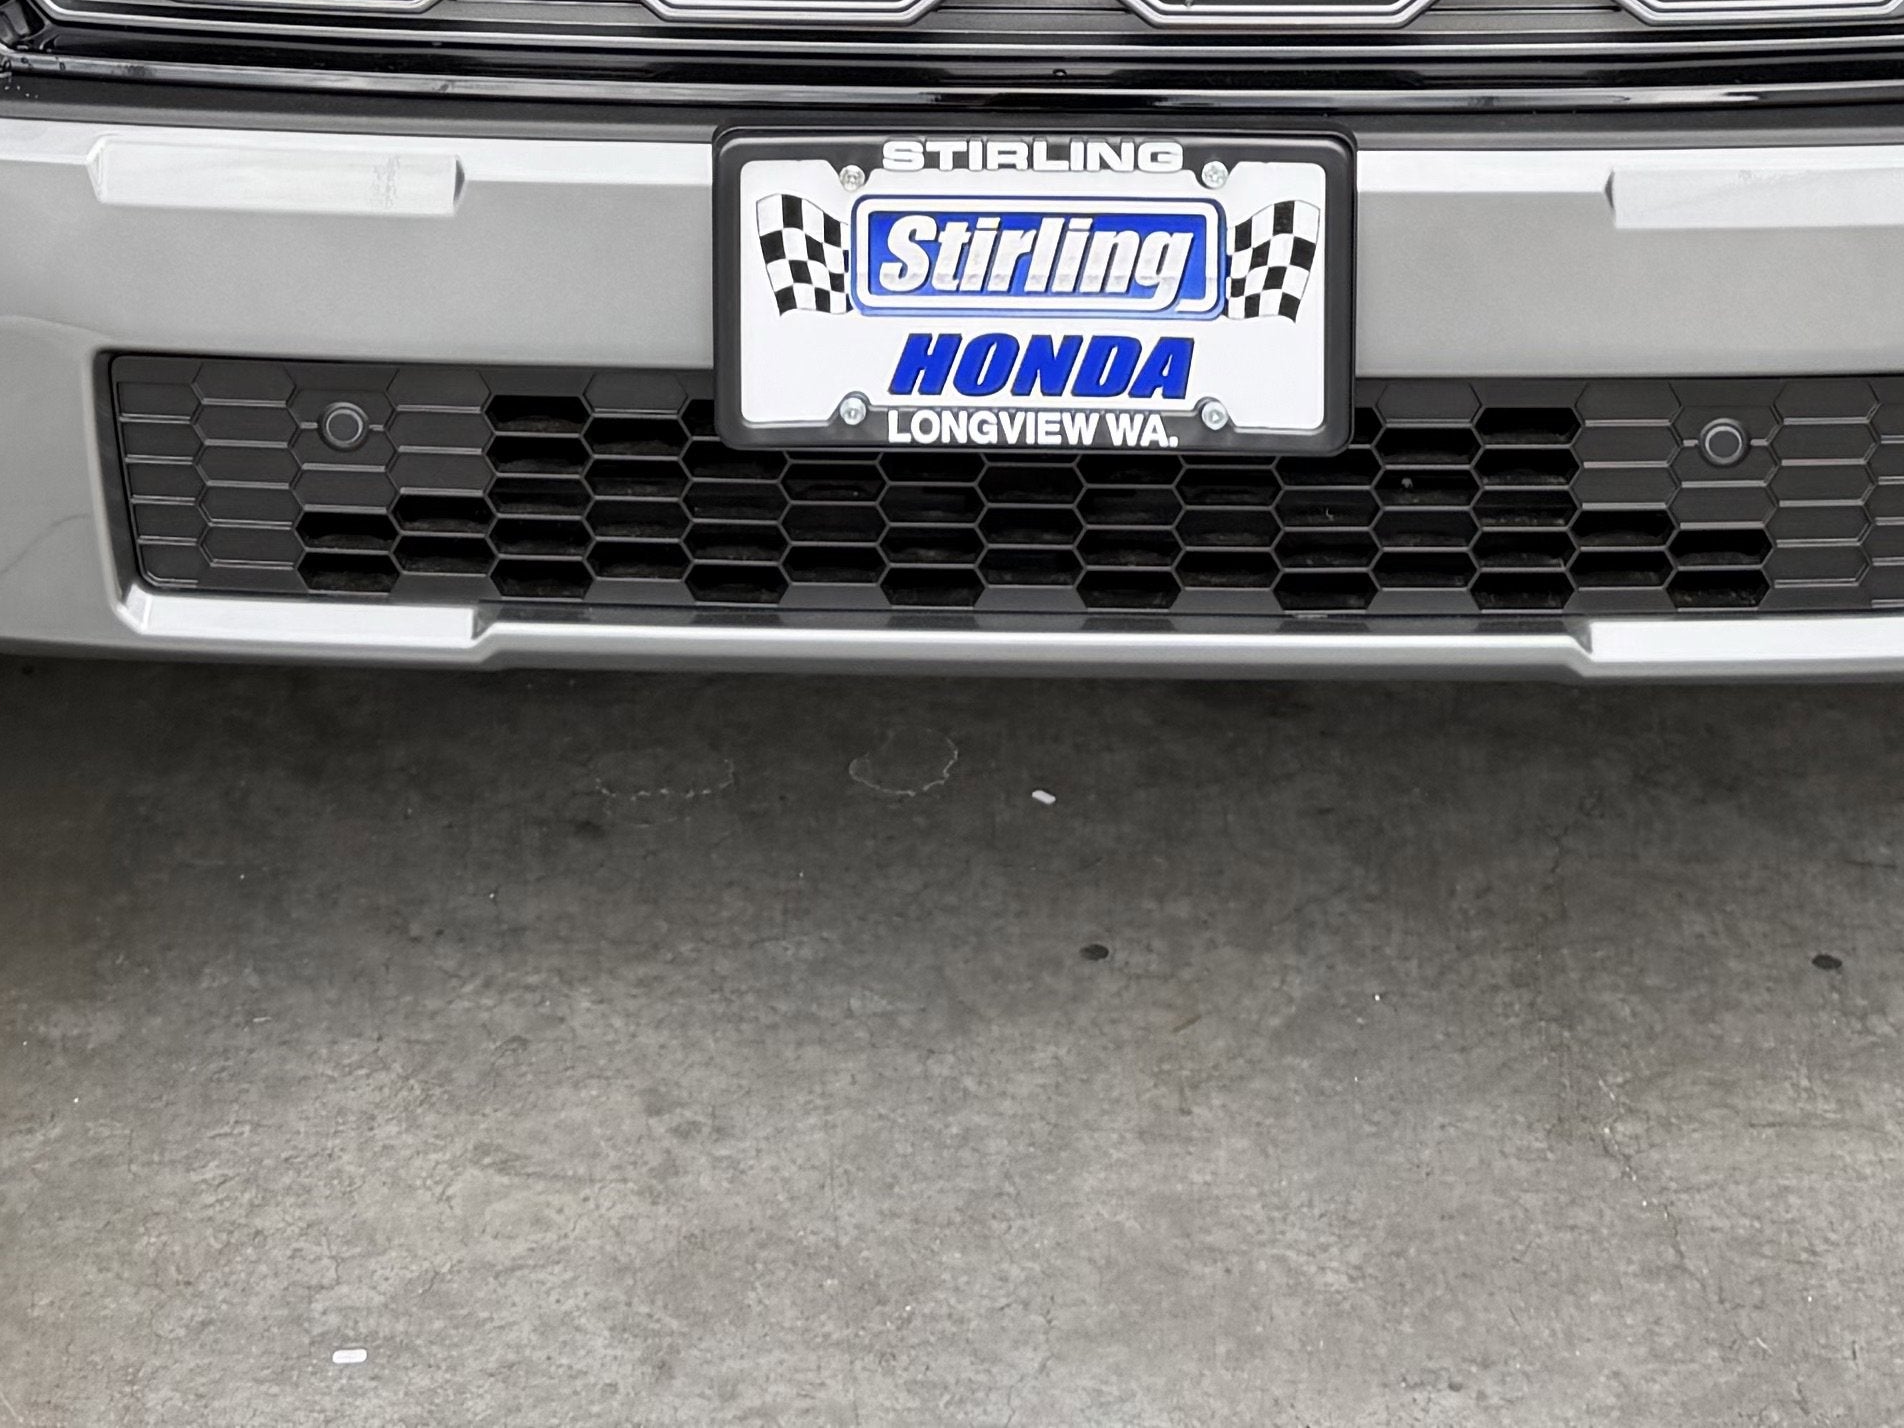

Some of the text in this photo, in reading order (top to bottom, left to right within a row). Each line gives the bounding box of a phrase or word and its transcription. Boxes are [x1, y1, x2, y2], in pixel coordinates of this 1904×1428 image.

[881, 139, 1185, 173] STIRLING
[878, 214, 1195, 312] Stirling
[887, 332, 1196, 400] HONDA
[887, 409, 1180, 448] LONGVIEW WA.
